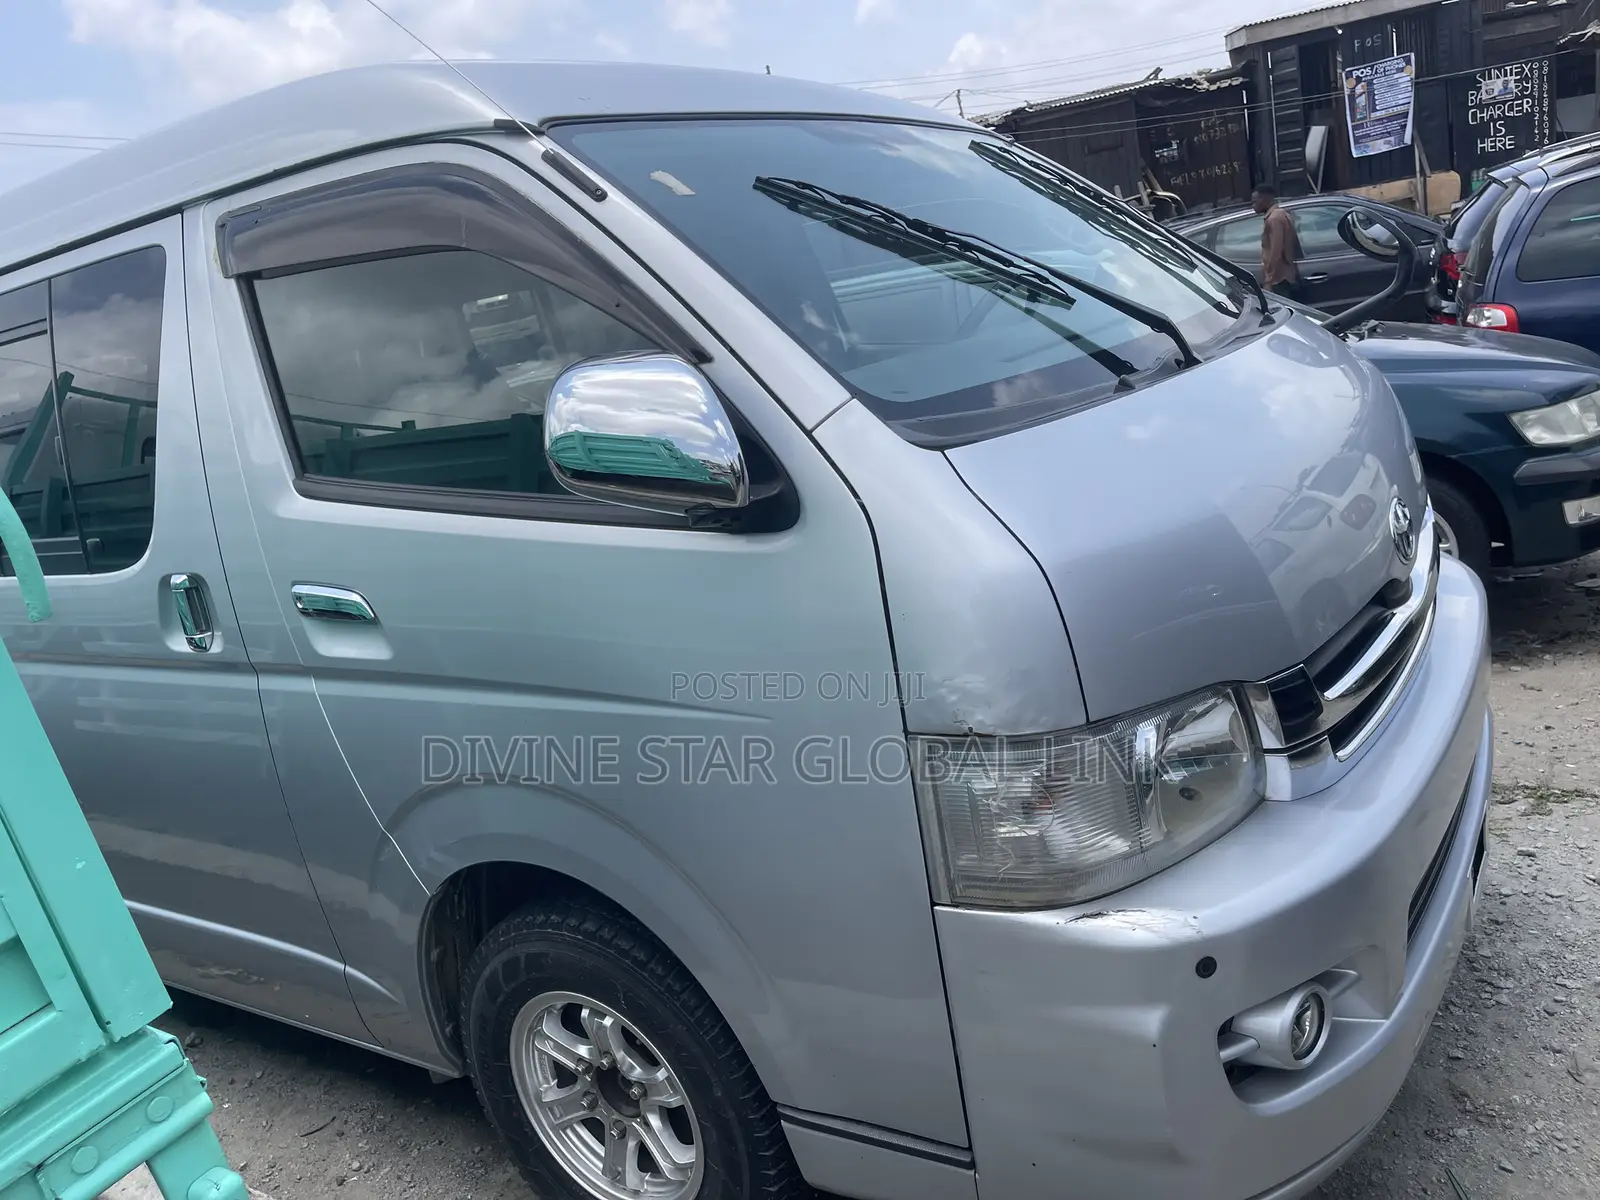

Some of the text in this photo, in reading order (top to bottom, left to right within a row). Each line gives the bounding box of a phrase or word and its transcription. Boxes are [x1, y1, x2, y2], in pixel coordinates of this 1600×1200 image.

[1354, 34, 1381, 52] POS
[1476, 63, 1532, 87] SUNTEX
[1468, 98, 1532, 125] CHARGER
[1490, 120, 1506, 136] IS
[1477, 135, 1515, 155] HERE
